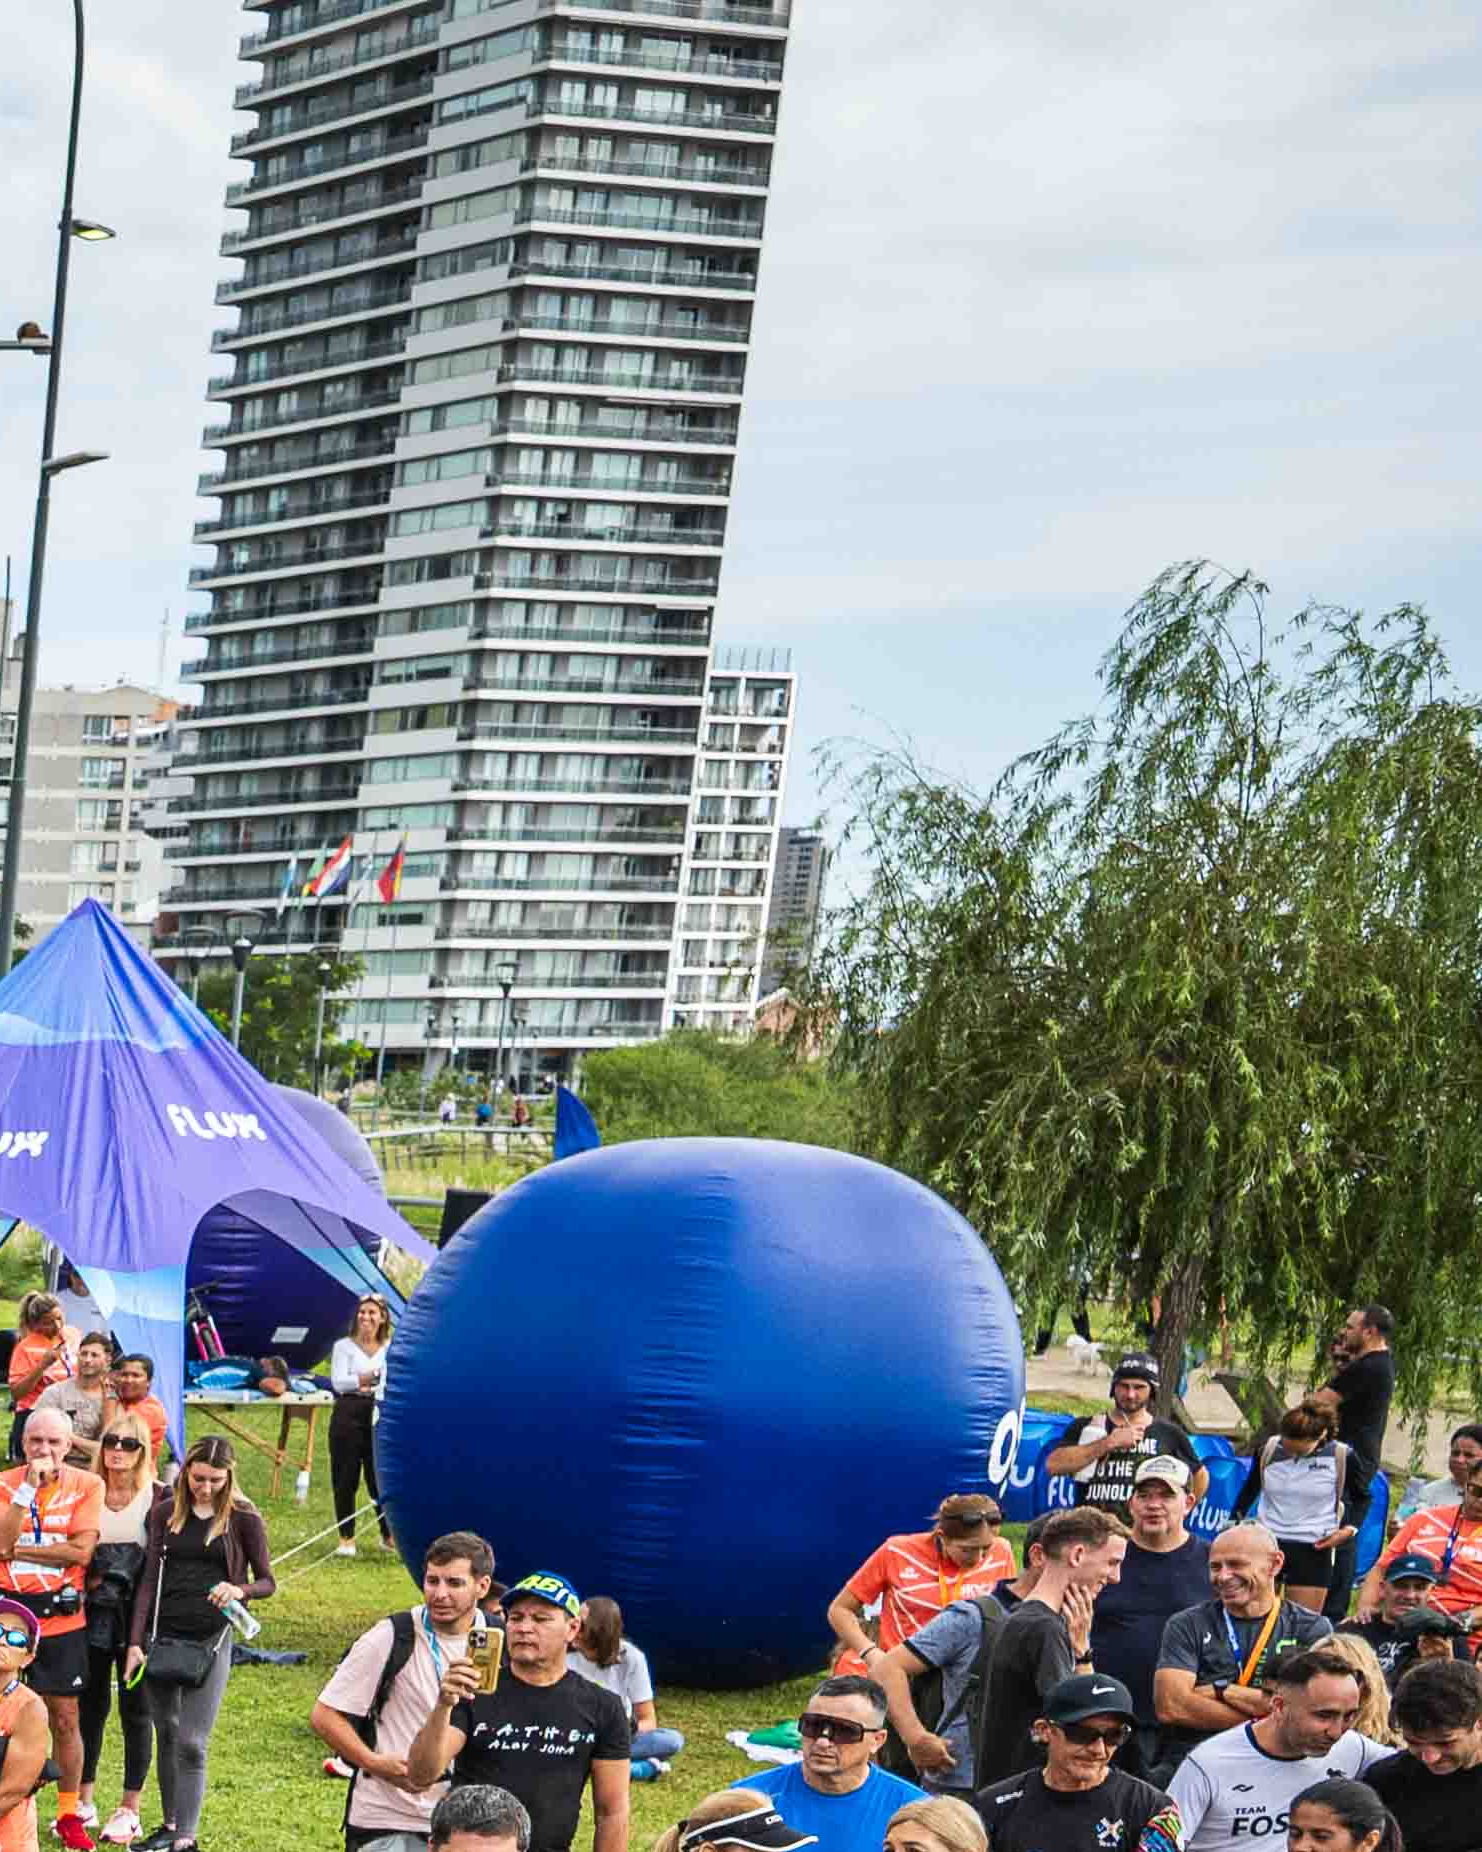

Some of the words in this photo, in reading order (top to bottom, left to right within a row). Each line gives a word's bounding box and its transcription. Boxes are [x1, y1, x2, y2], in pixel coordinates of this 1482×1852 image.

[1107, 1459, 1134, 1477] THE
[1235, 1805, 1267, 1816] TEAM
[1230, 1813, 1292, 1838] FOS
